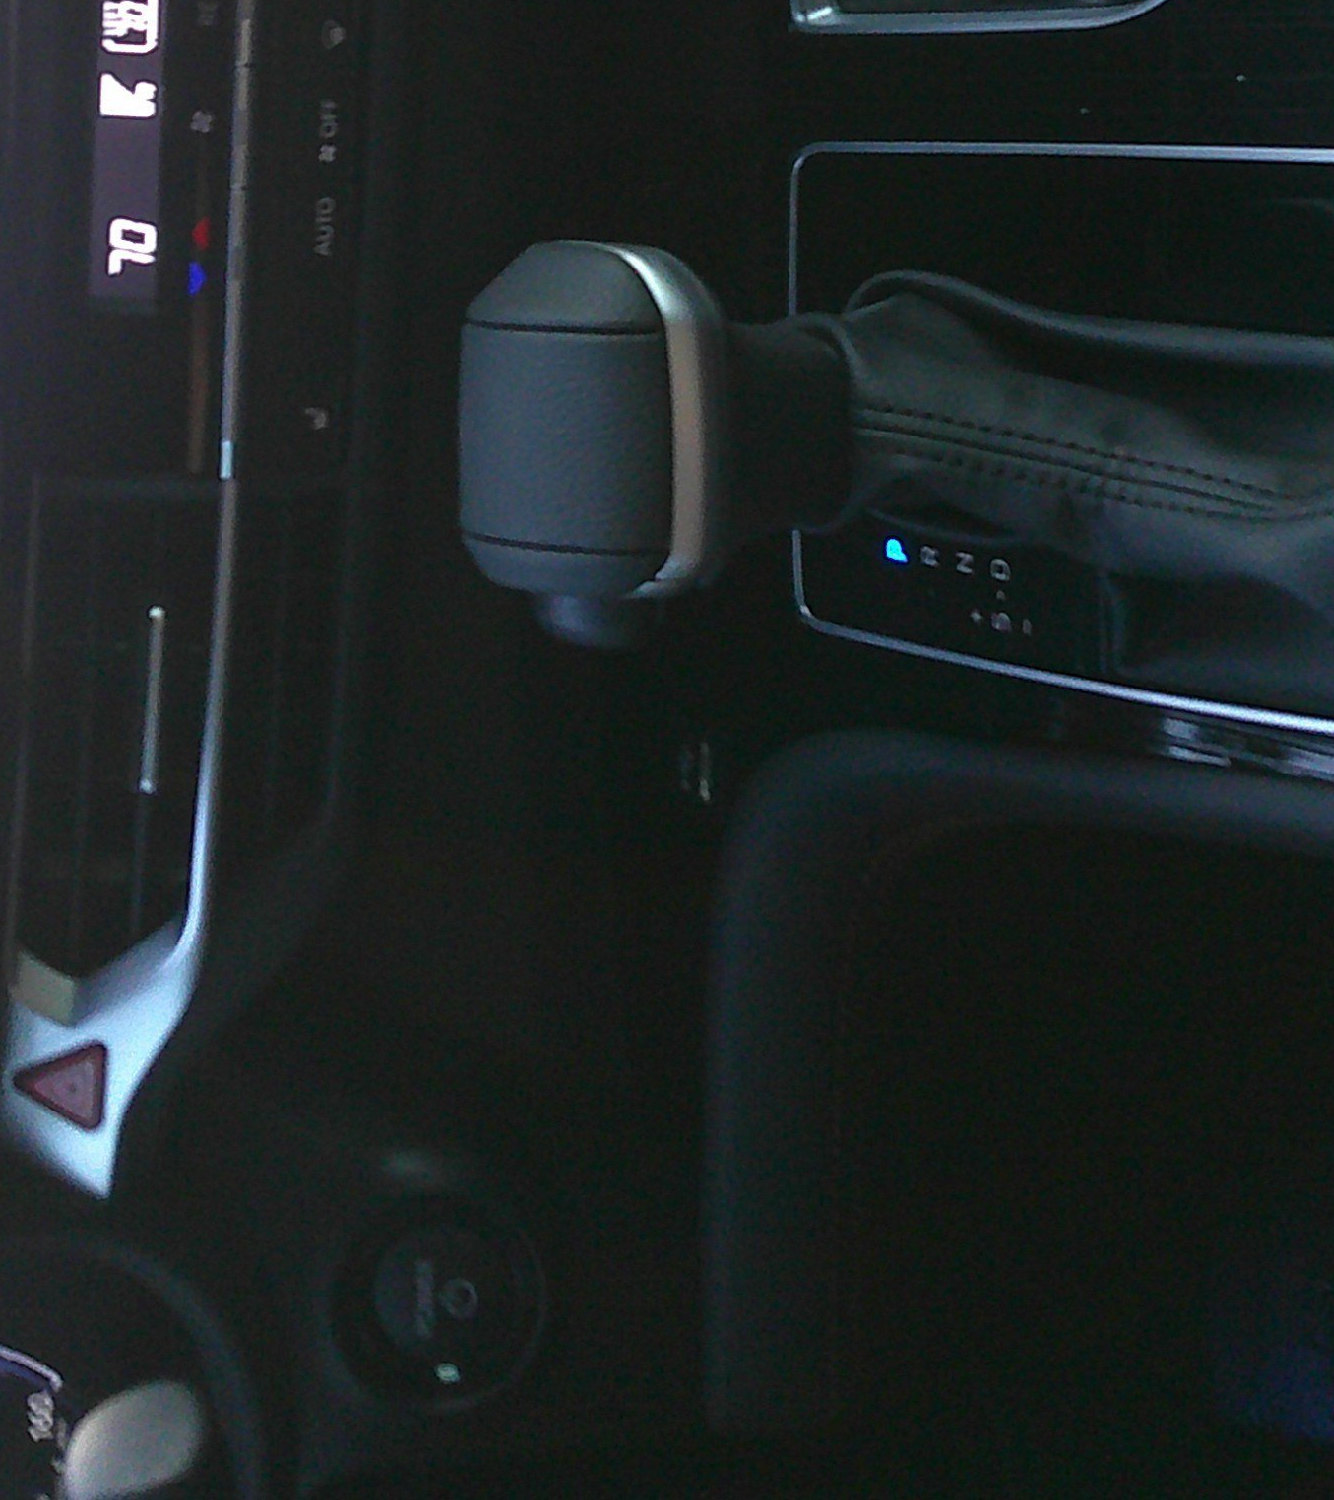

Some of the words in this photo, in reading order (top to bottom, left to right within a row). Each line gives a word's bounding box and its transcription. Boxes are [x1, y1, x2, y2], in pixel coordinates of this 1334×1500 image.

[318, 99, 339, 138] OFF
[107, 216, 157, 276] 70
[313, 197, 337, 257] AUTO
[886, 538, 909, 562] P
[956, 552, 974, 574] N
[26, 1390, 54, 1442] 160
